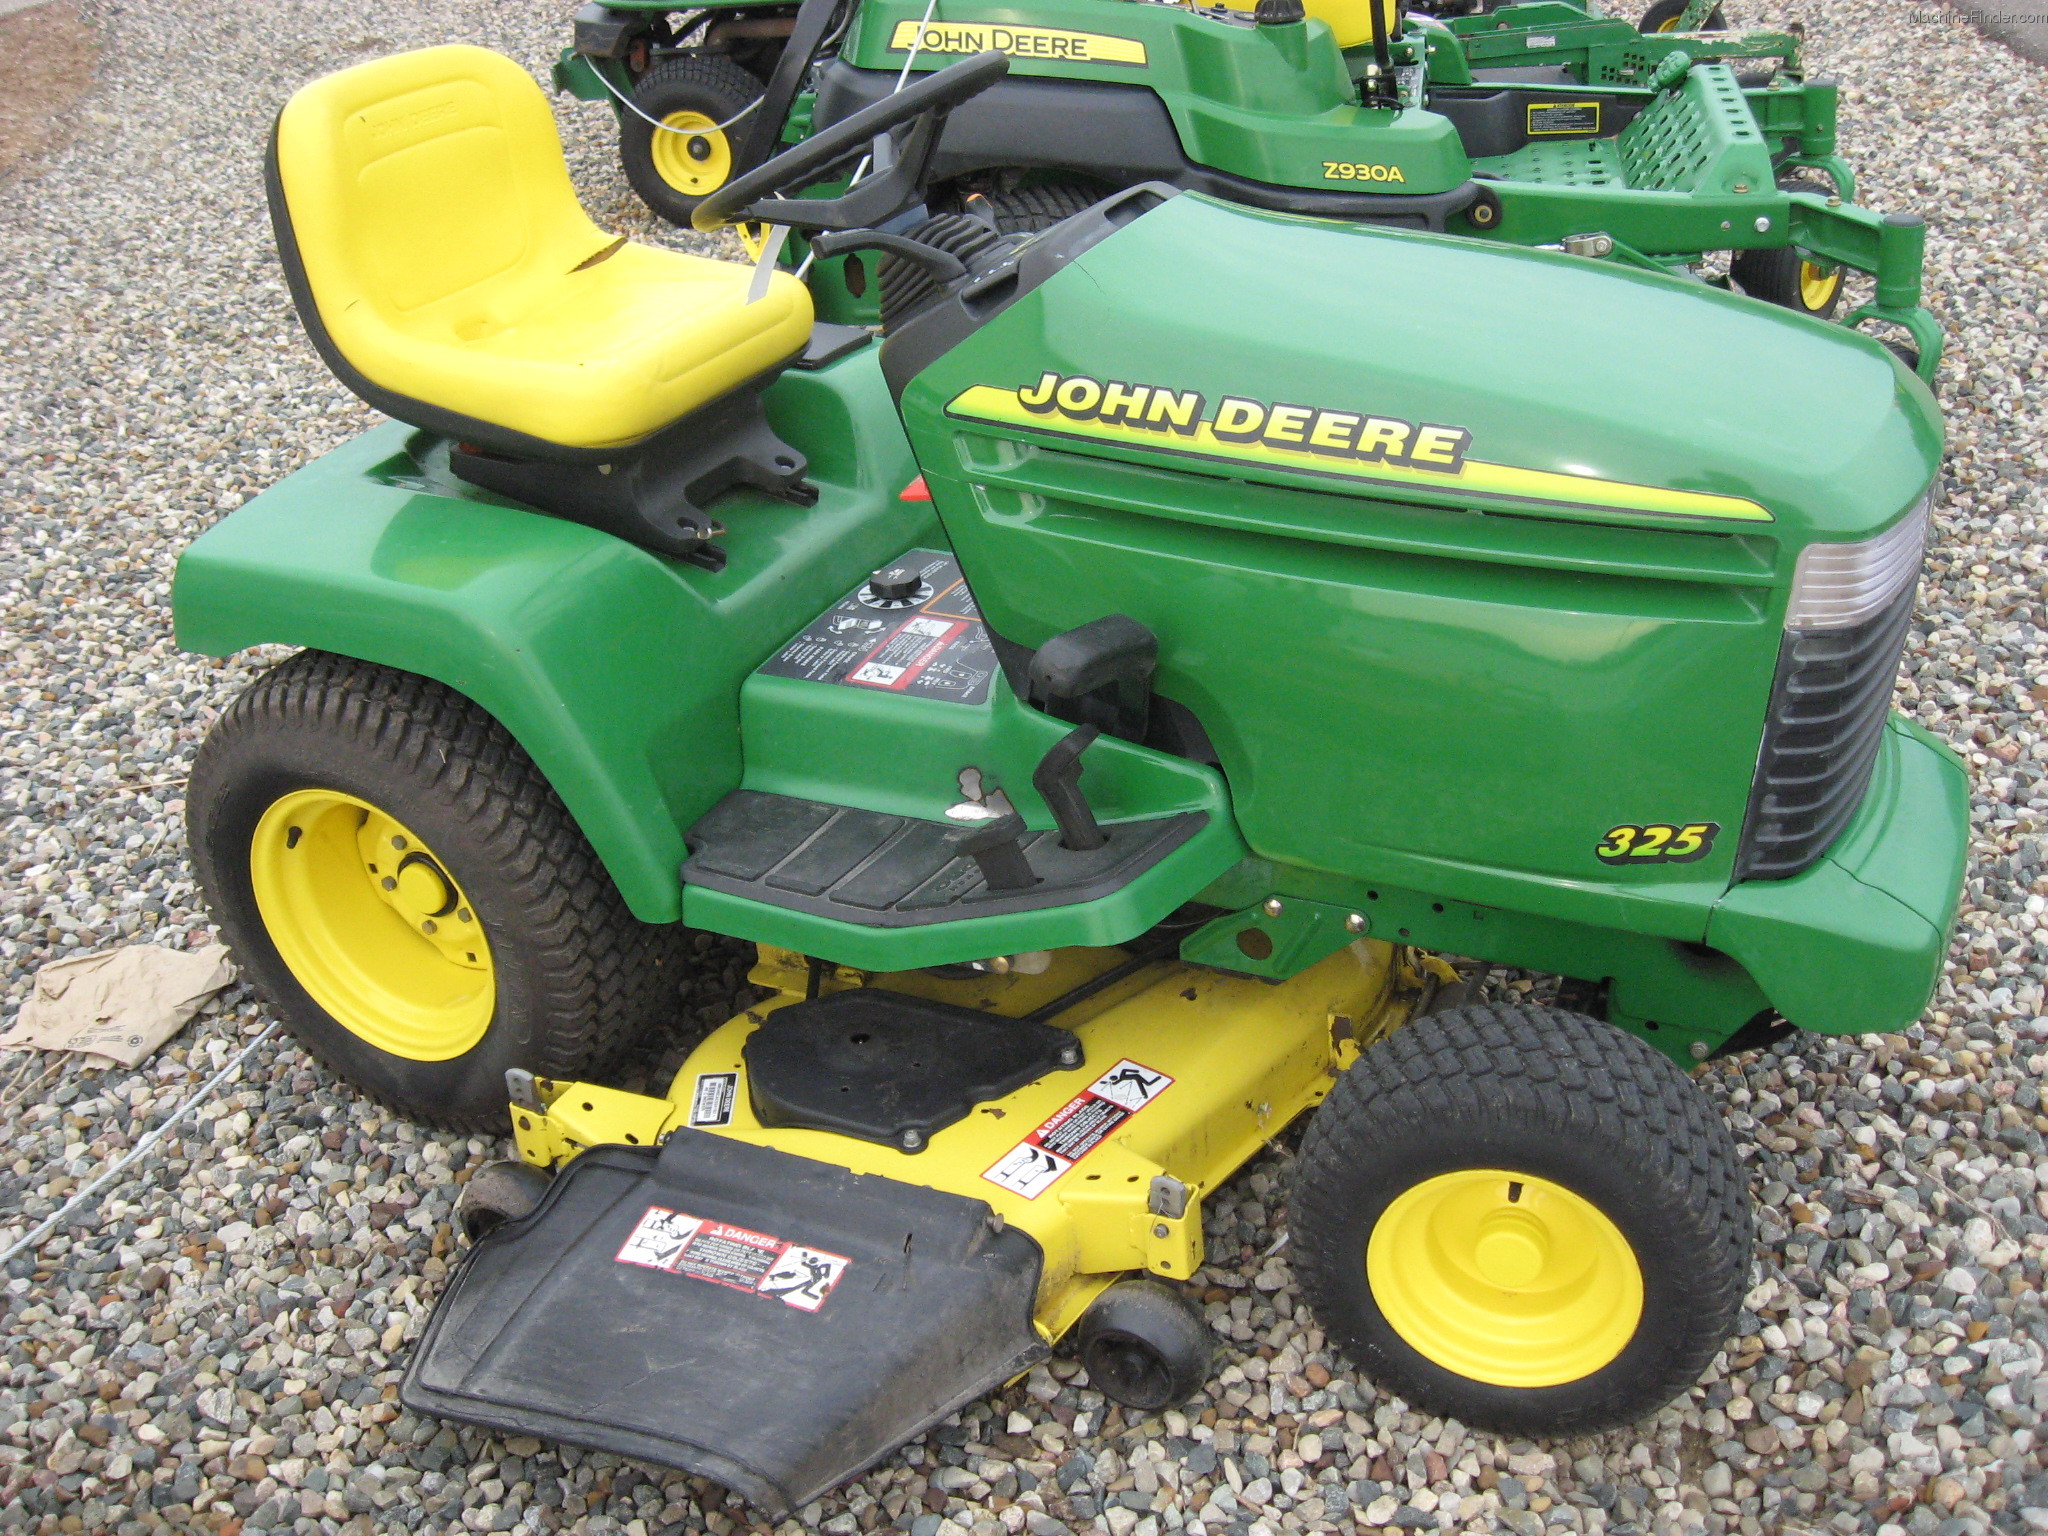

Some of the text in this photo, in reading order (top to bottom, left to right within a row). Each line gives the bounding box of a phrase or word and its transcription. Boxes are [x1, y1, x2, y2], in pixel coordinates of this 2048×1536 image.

[992, 29, 1088, 58] DEERE
[1322, 161, 1405, 184] Z930A
[1018, 372, 1471, 472] JOHN DEERE
[1596, 823, 1717, 863] 325
[1044, 1098, 1086, 1130] DANGER
[724, 1228, 777, 1248] DANGER
